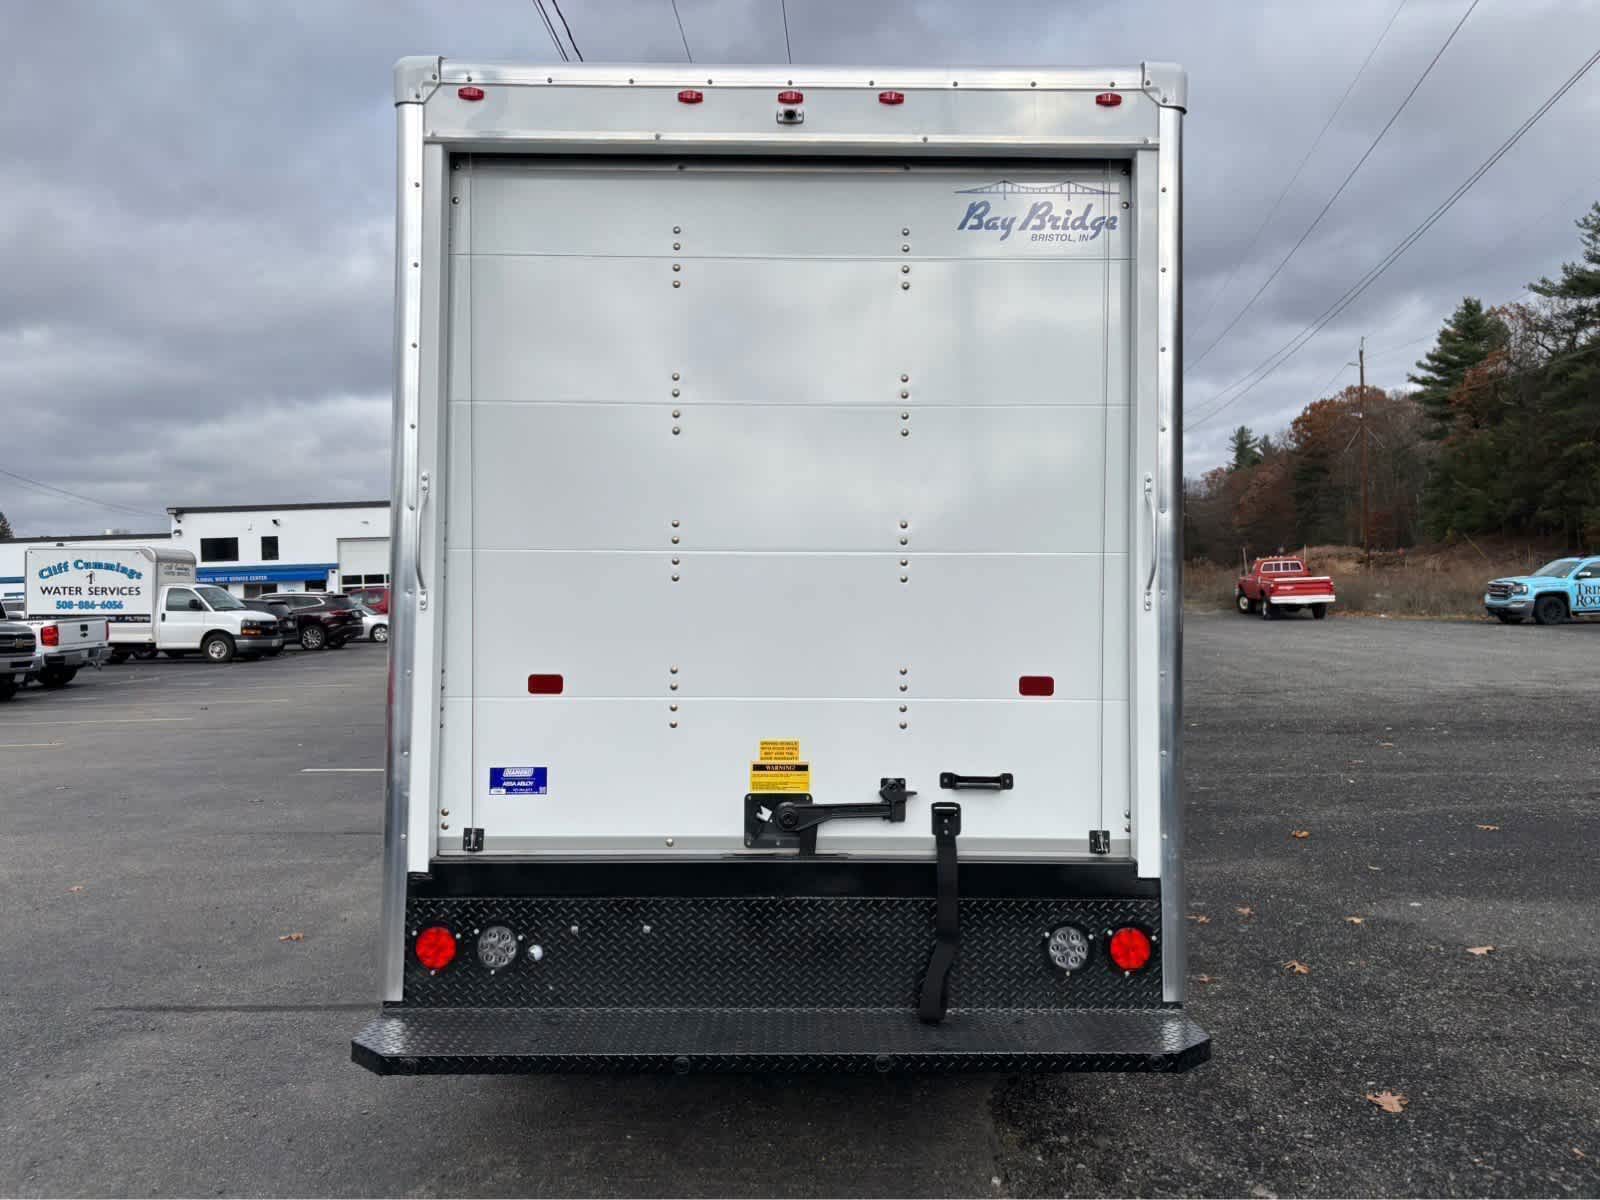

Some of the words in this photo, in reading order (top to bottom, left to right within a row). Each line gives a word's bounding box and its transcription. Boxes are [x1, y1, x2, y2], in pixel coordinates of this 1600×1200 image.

[957, 200, 1017, 241] Bay
[1018, 200, 1119, 241] Bridge
[1031, 233, 1076, 243] BRISTOL,
[1078, 233, 1090, 242] IN
[38, 561, 69, 580] Cliff
[73, 559, 143, 580] Cummings
[40, 586, 82, 596] WATER
[88, 586, 141, 596] SERVICES
